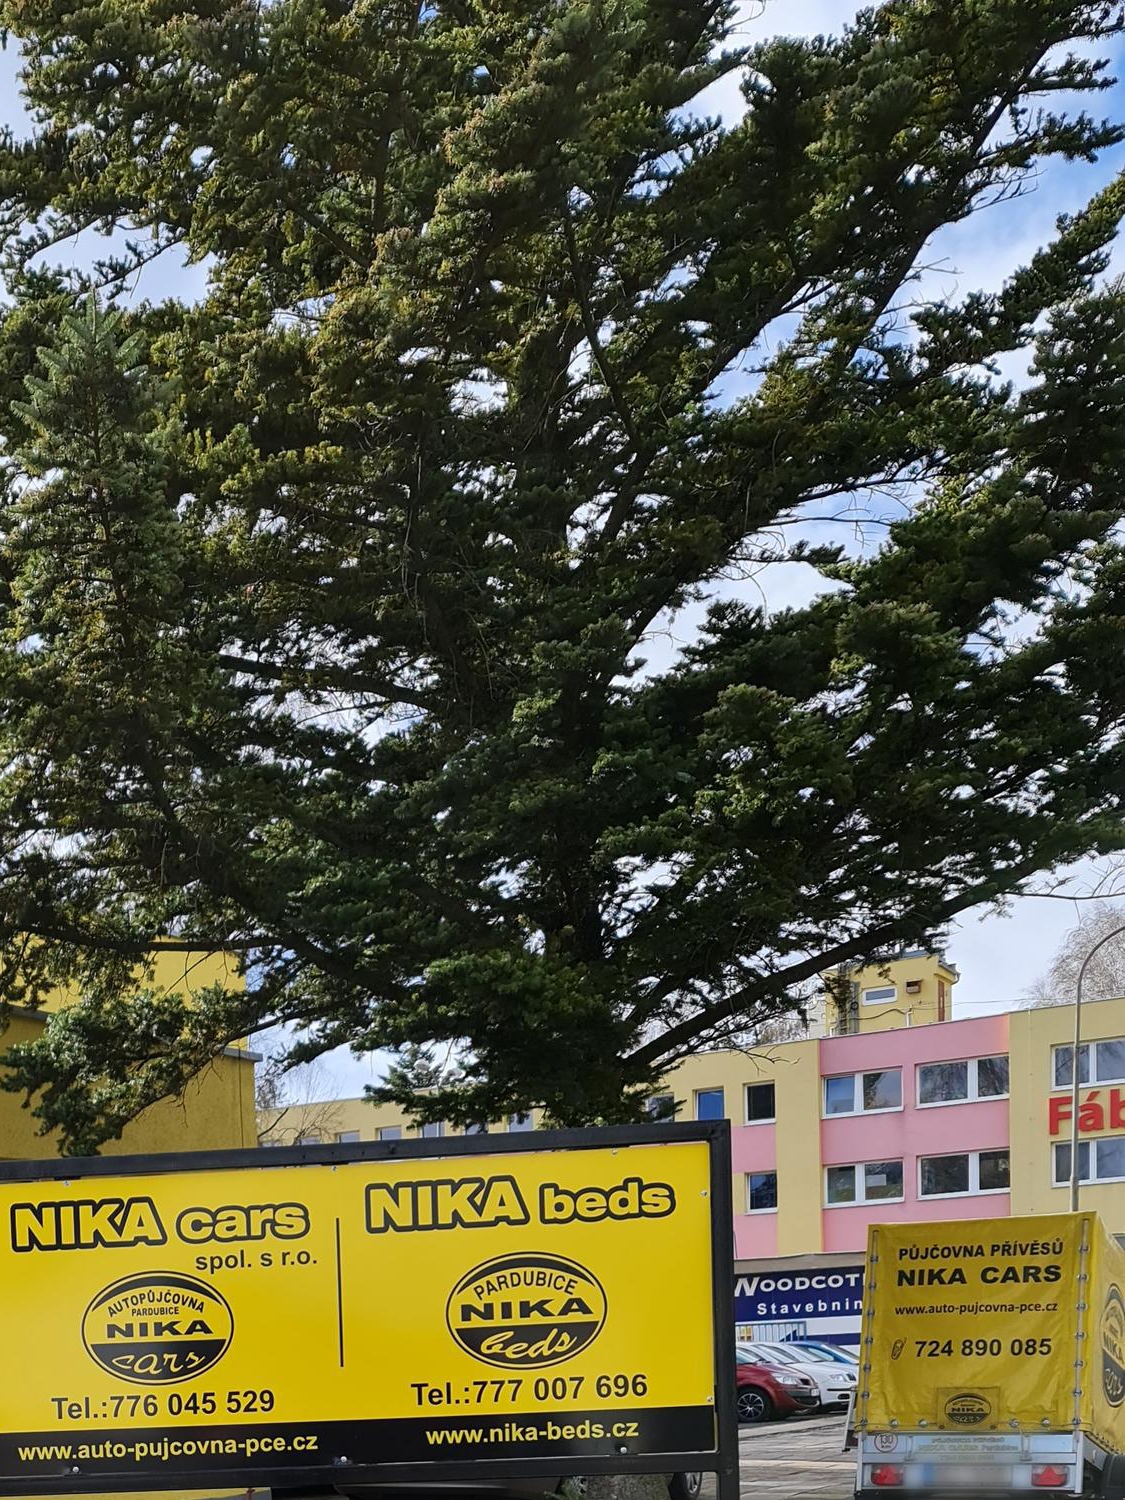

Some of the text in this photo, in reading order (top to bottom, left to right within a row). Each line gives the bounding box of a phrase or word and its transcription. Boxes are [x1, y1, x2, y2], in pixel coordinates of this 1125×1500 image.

[365, 1175, 676, 1234] NIKA beds
[11, 1197, 310, 1252] NIKA cars
[195, 1250, 318, 1274] spol. s r.o.
[899, 1238, 1064, 1261] PŮJČOVNA PŘÍVĚSŮ
[473, 1270, 578, 1300] PARDUBICE
[734, 1273, 865, 1297] WOODCOT
[897, 1265, 1062, 1287] NIKA CARS
[107, 1289, 205, 1318] AUTOPŮJČOVNA
[131, 1306, 180, 1317] PARDUBICE
[461, 1297, 594, 1322] NIKA
[895, 1301, 1058, 1316] www.auto-pujcovna-pce.cz
[106, 1320, 214, 1339] NIKA
[480, 1328, 577, 1359] beds
[914, 1338, 1052, 1357] 724 890 085
[112, 1352, 205, 1375] cars
[411, 1373, 648, 1406] Tel.:777 007 696
[51, 1389, 275, 1420] Tel.:776 045 529
[426, 1420, 639, 1445] www.nika-beds.cz
[18, 1434, 318, 1461] www.auto-pujcovna-pce.cz
